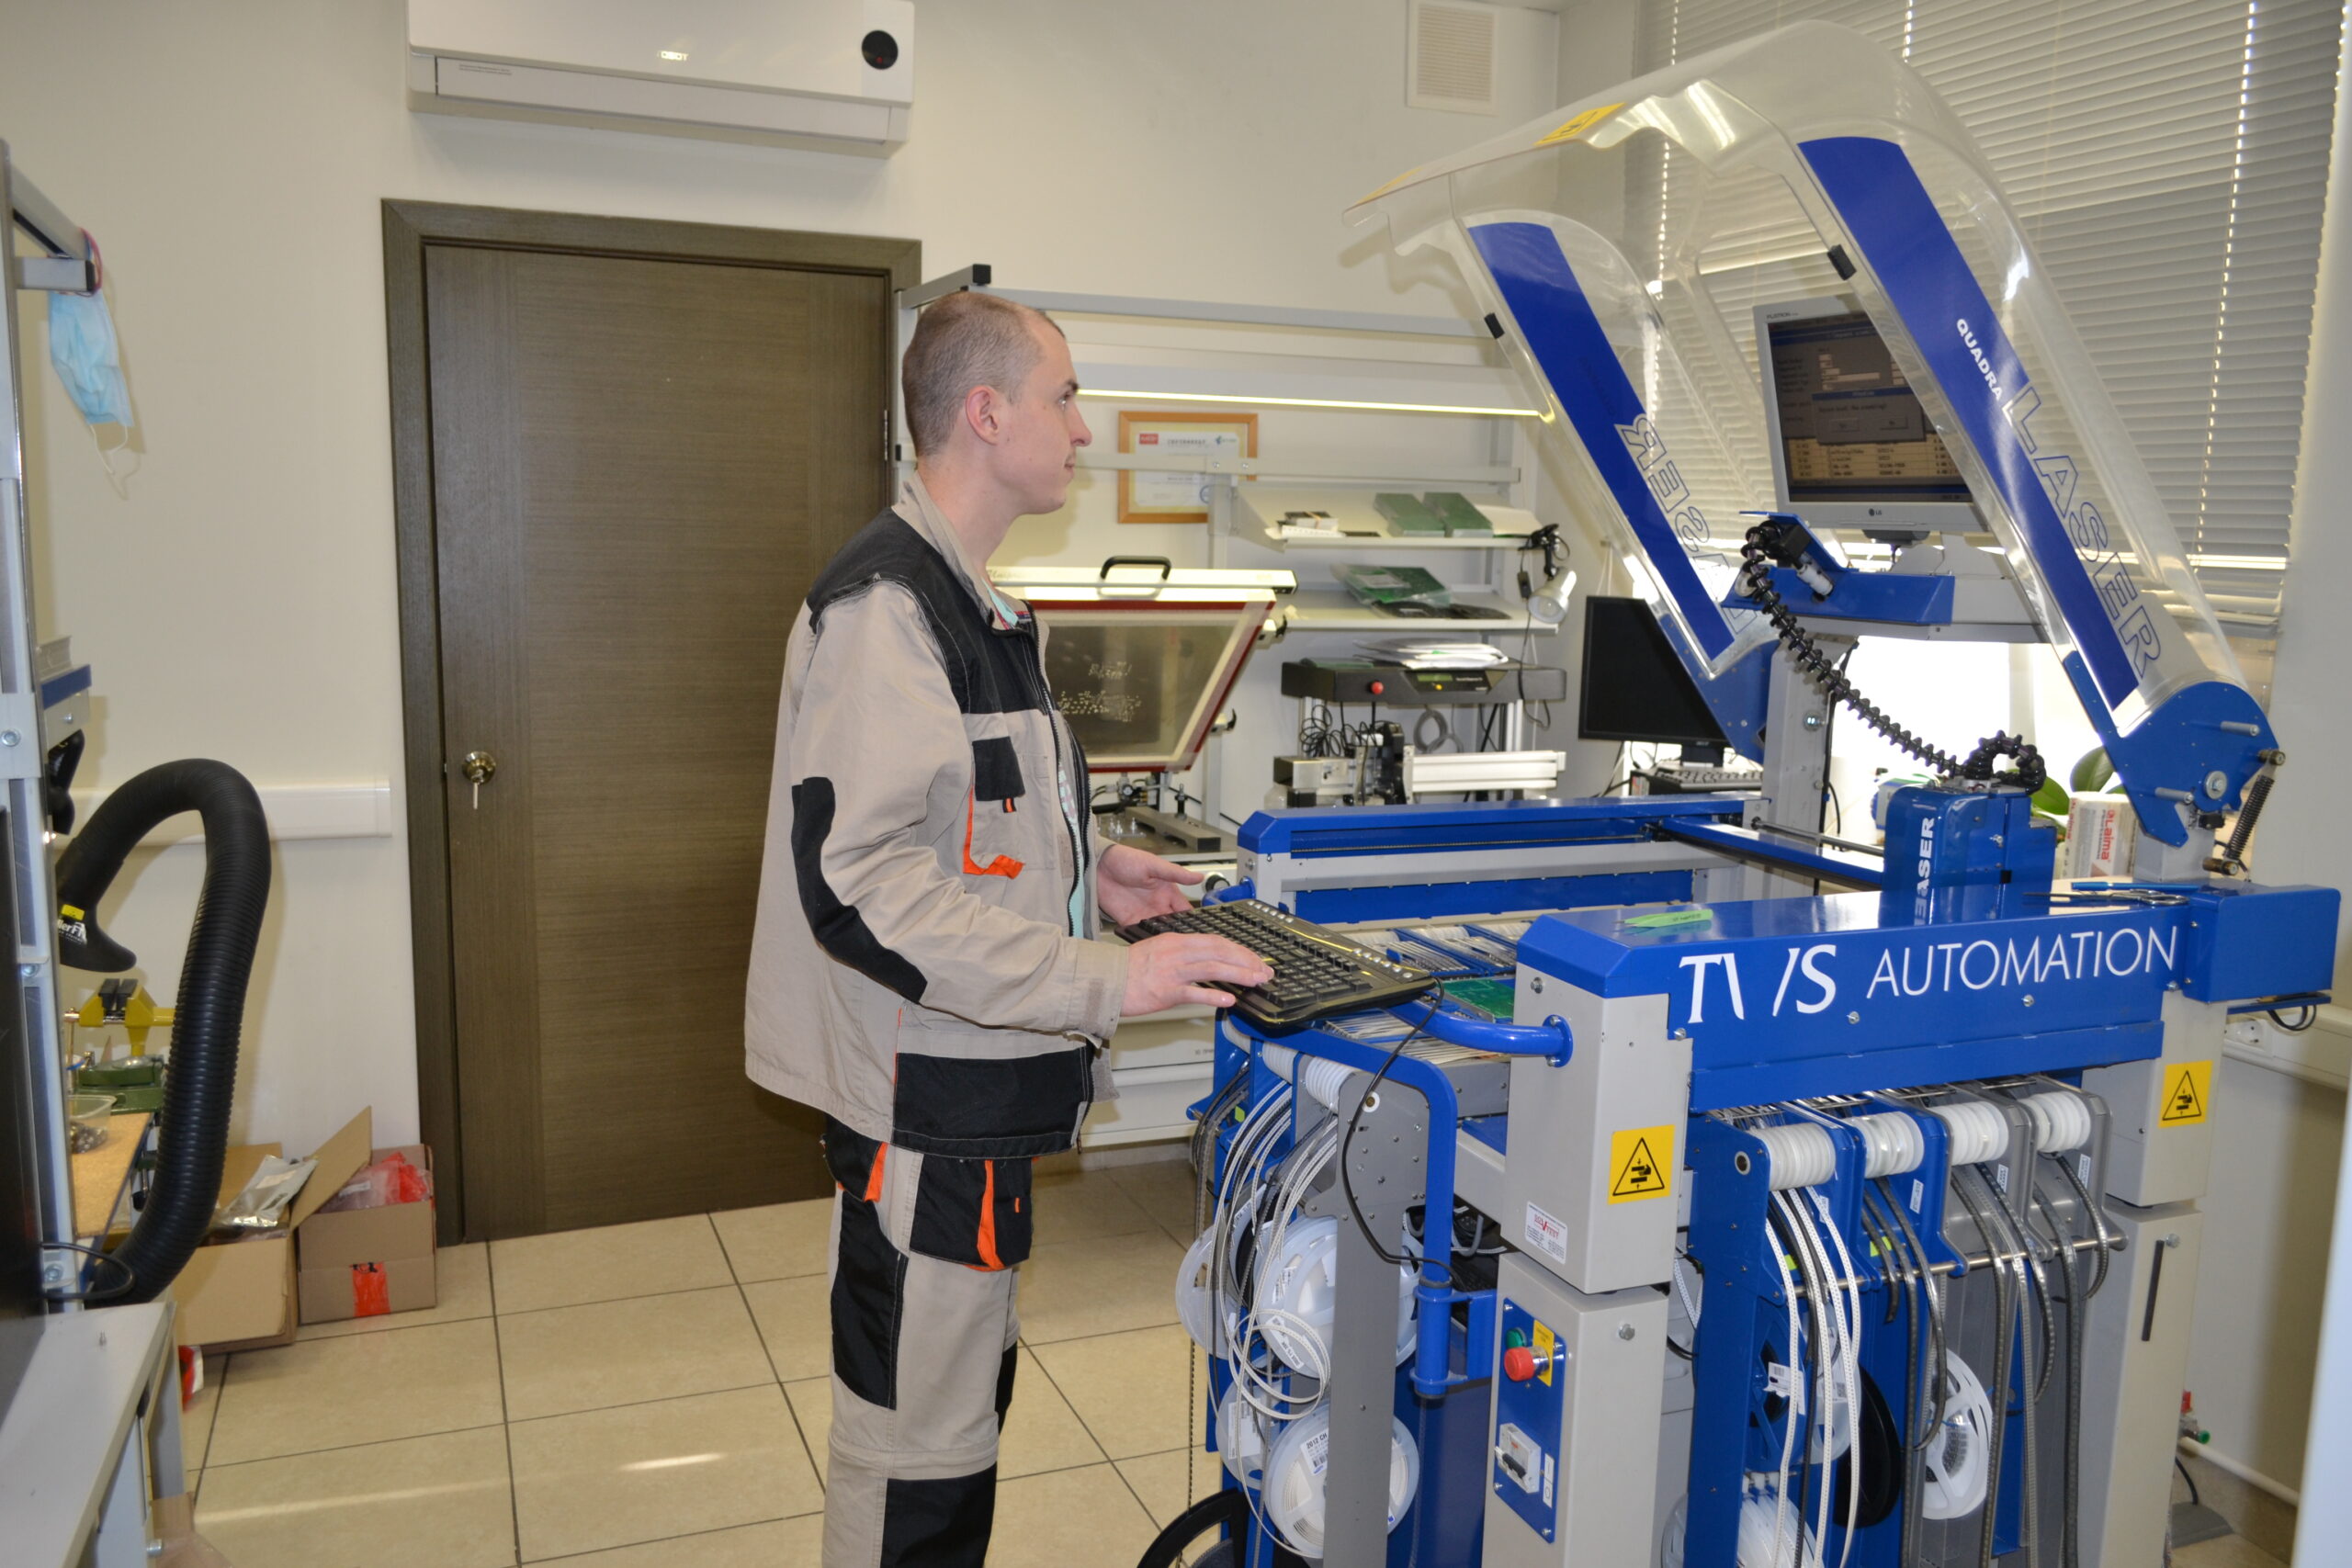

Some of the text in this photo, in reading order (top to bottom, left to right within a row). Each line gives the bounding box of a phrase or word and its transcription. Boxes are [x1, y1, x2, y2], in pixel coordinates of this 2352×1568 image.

[1957, 318, 2004, 402] QUADRA
[2001, 387, 2162, 679] LASER
[1866, 925, 2177, 999] AUTOMATION
